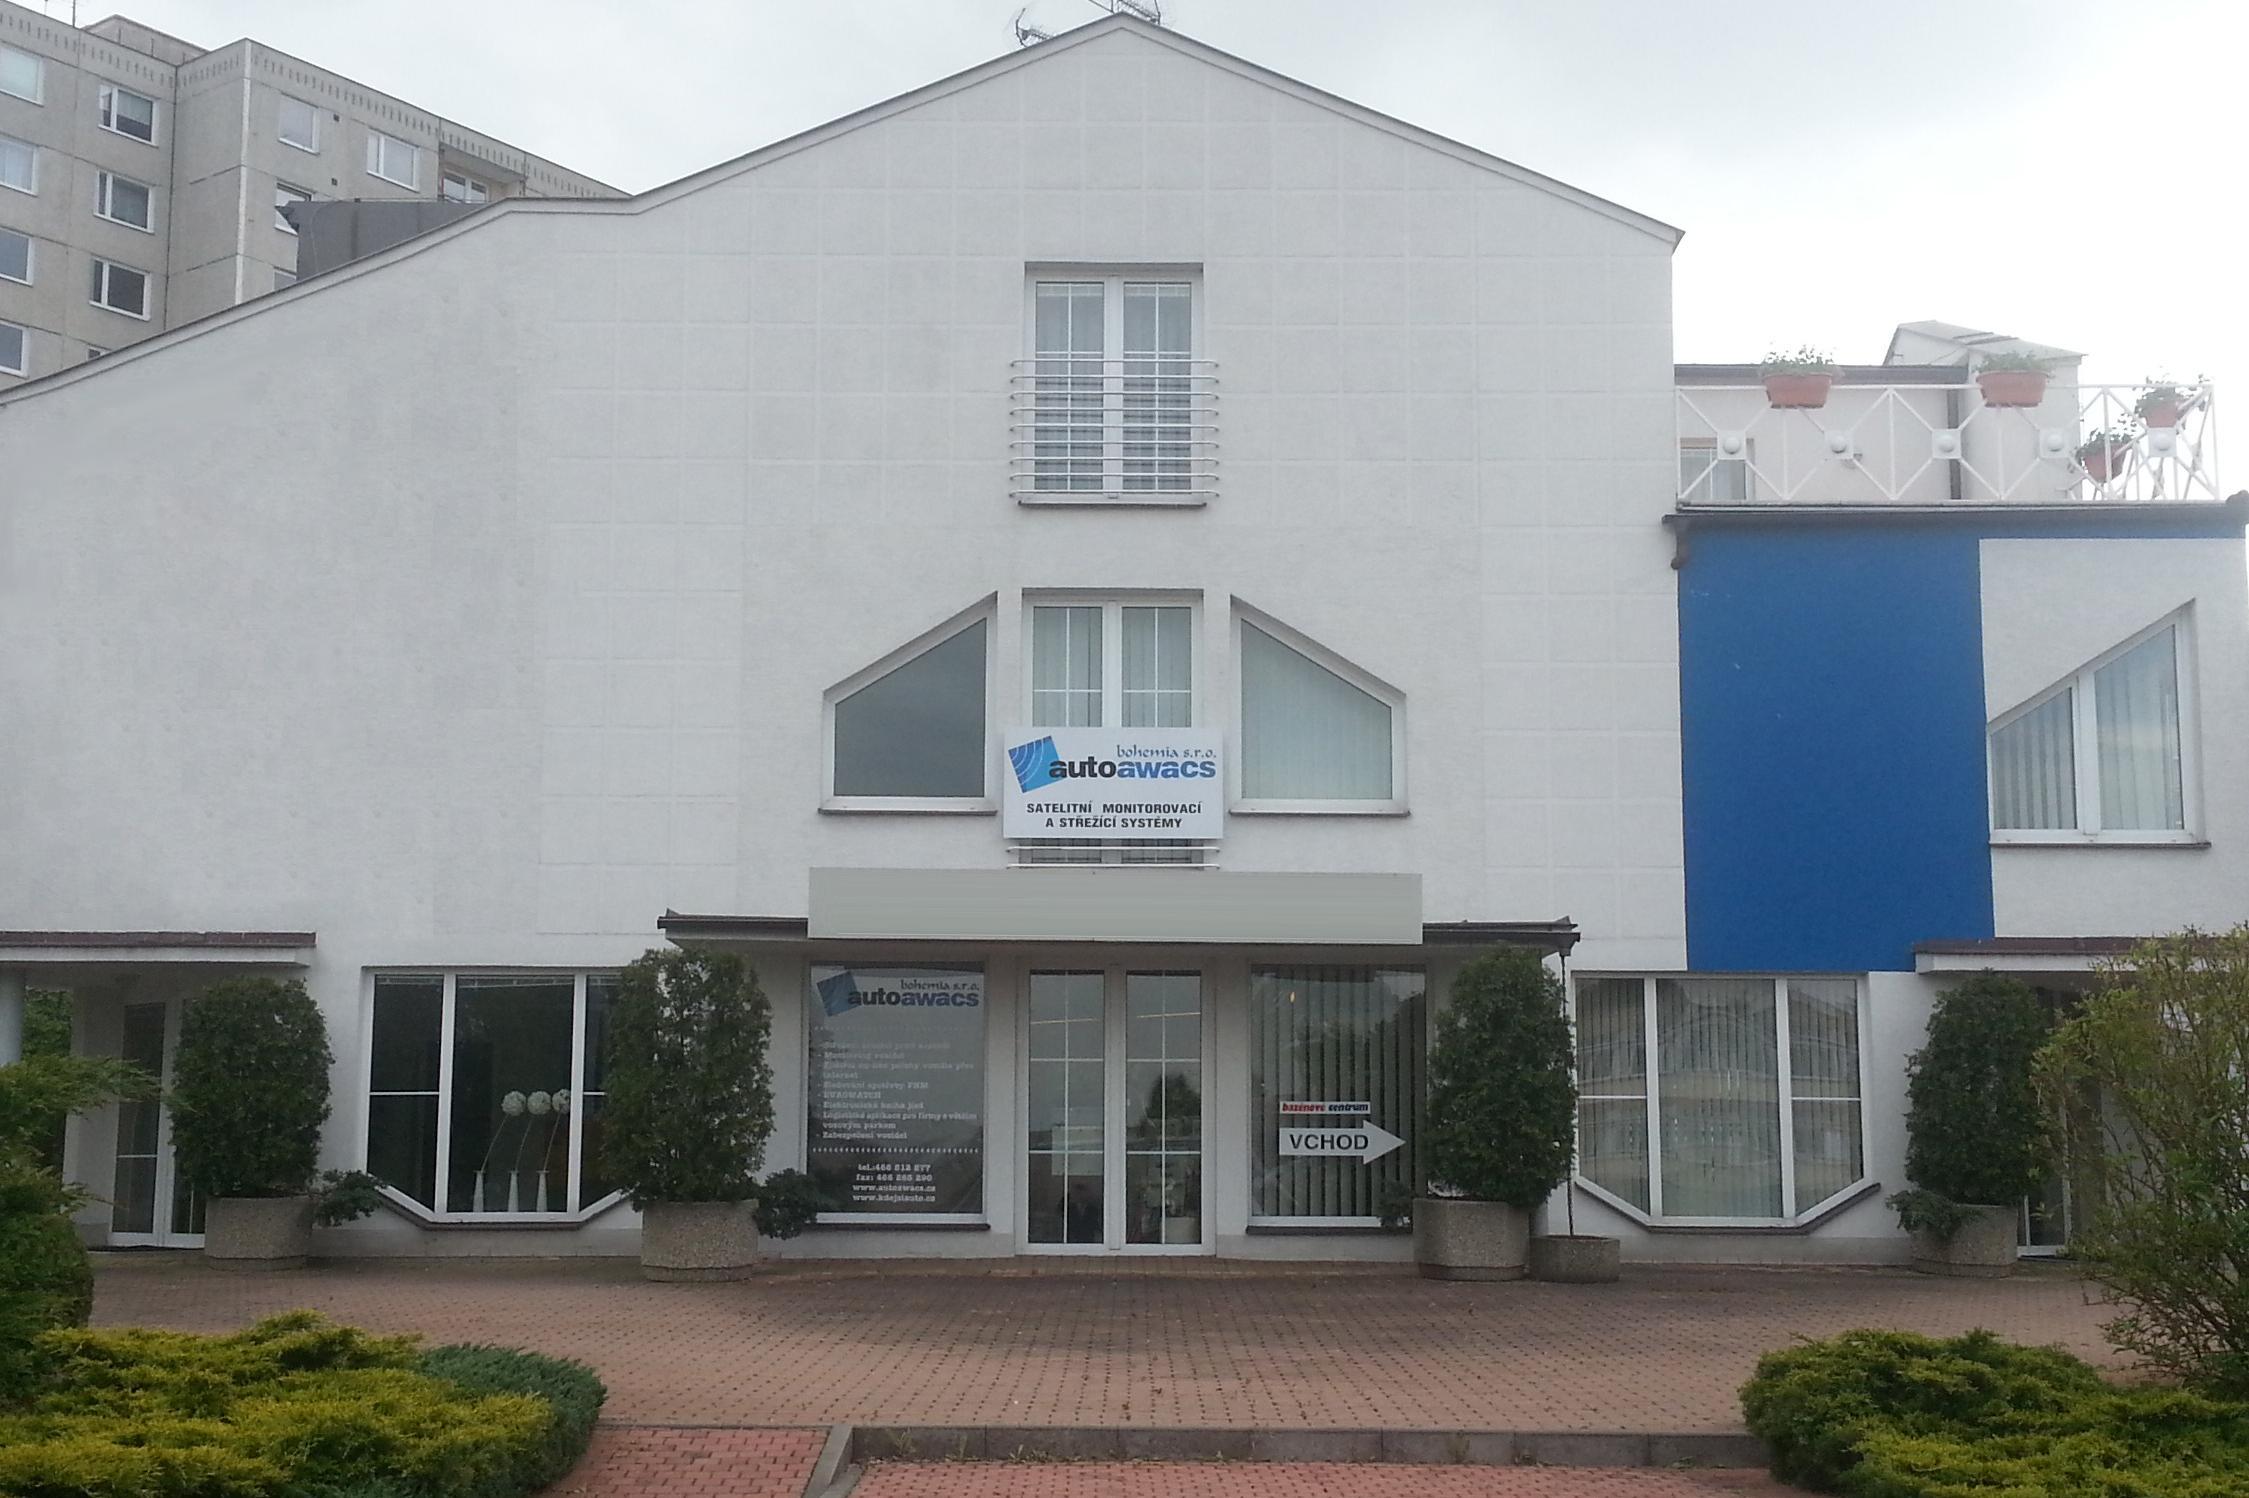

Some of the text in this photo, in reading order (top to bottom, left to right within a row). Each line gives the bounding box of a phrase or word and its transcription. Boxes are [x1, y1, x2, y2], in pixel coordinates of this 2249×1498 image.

[1117, 745, 1216, 758] bohemia s.r.o.
[1049, 756, 1216, 778] autoawacs
[1027, 800, 1202, 814] SATELITNÍ MONITOROVACÍ
[1045, 815, 1182, 828] A STŘEŽÍCÍ SYSTÉMY
[900, 980, 950, 990] bohemia
[848, 988, 979, 1007] autoawacs
[1328, 1103, 1369, 1112] centrum
[1289, 1134, 1369, 1150] VCHOD
